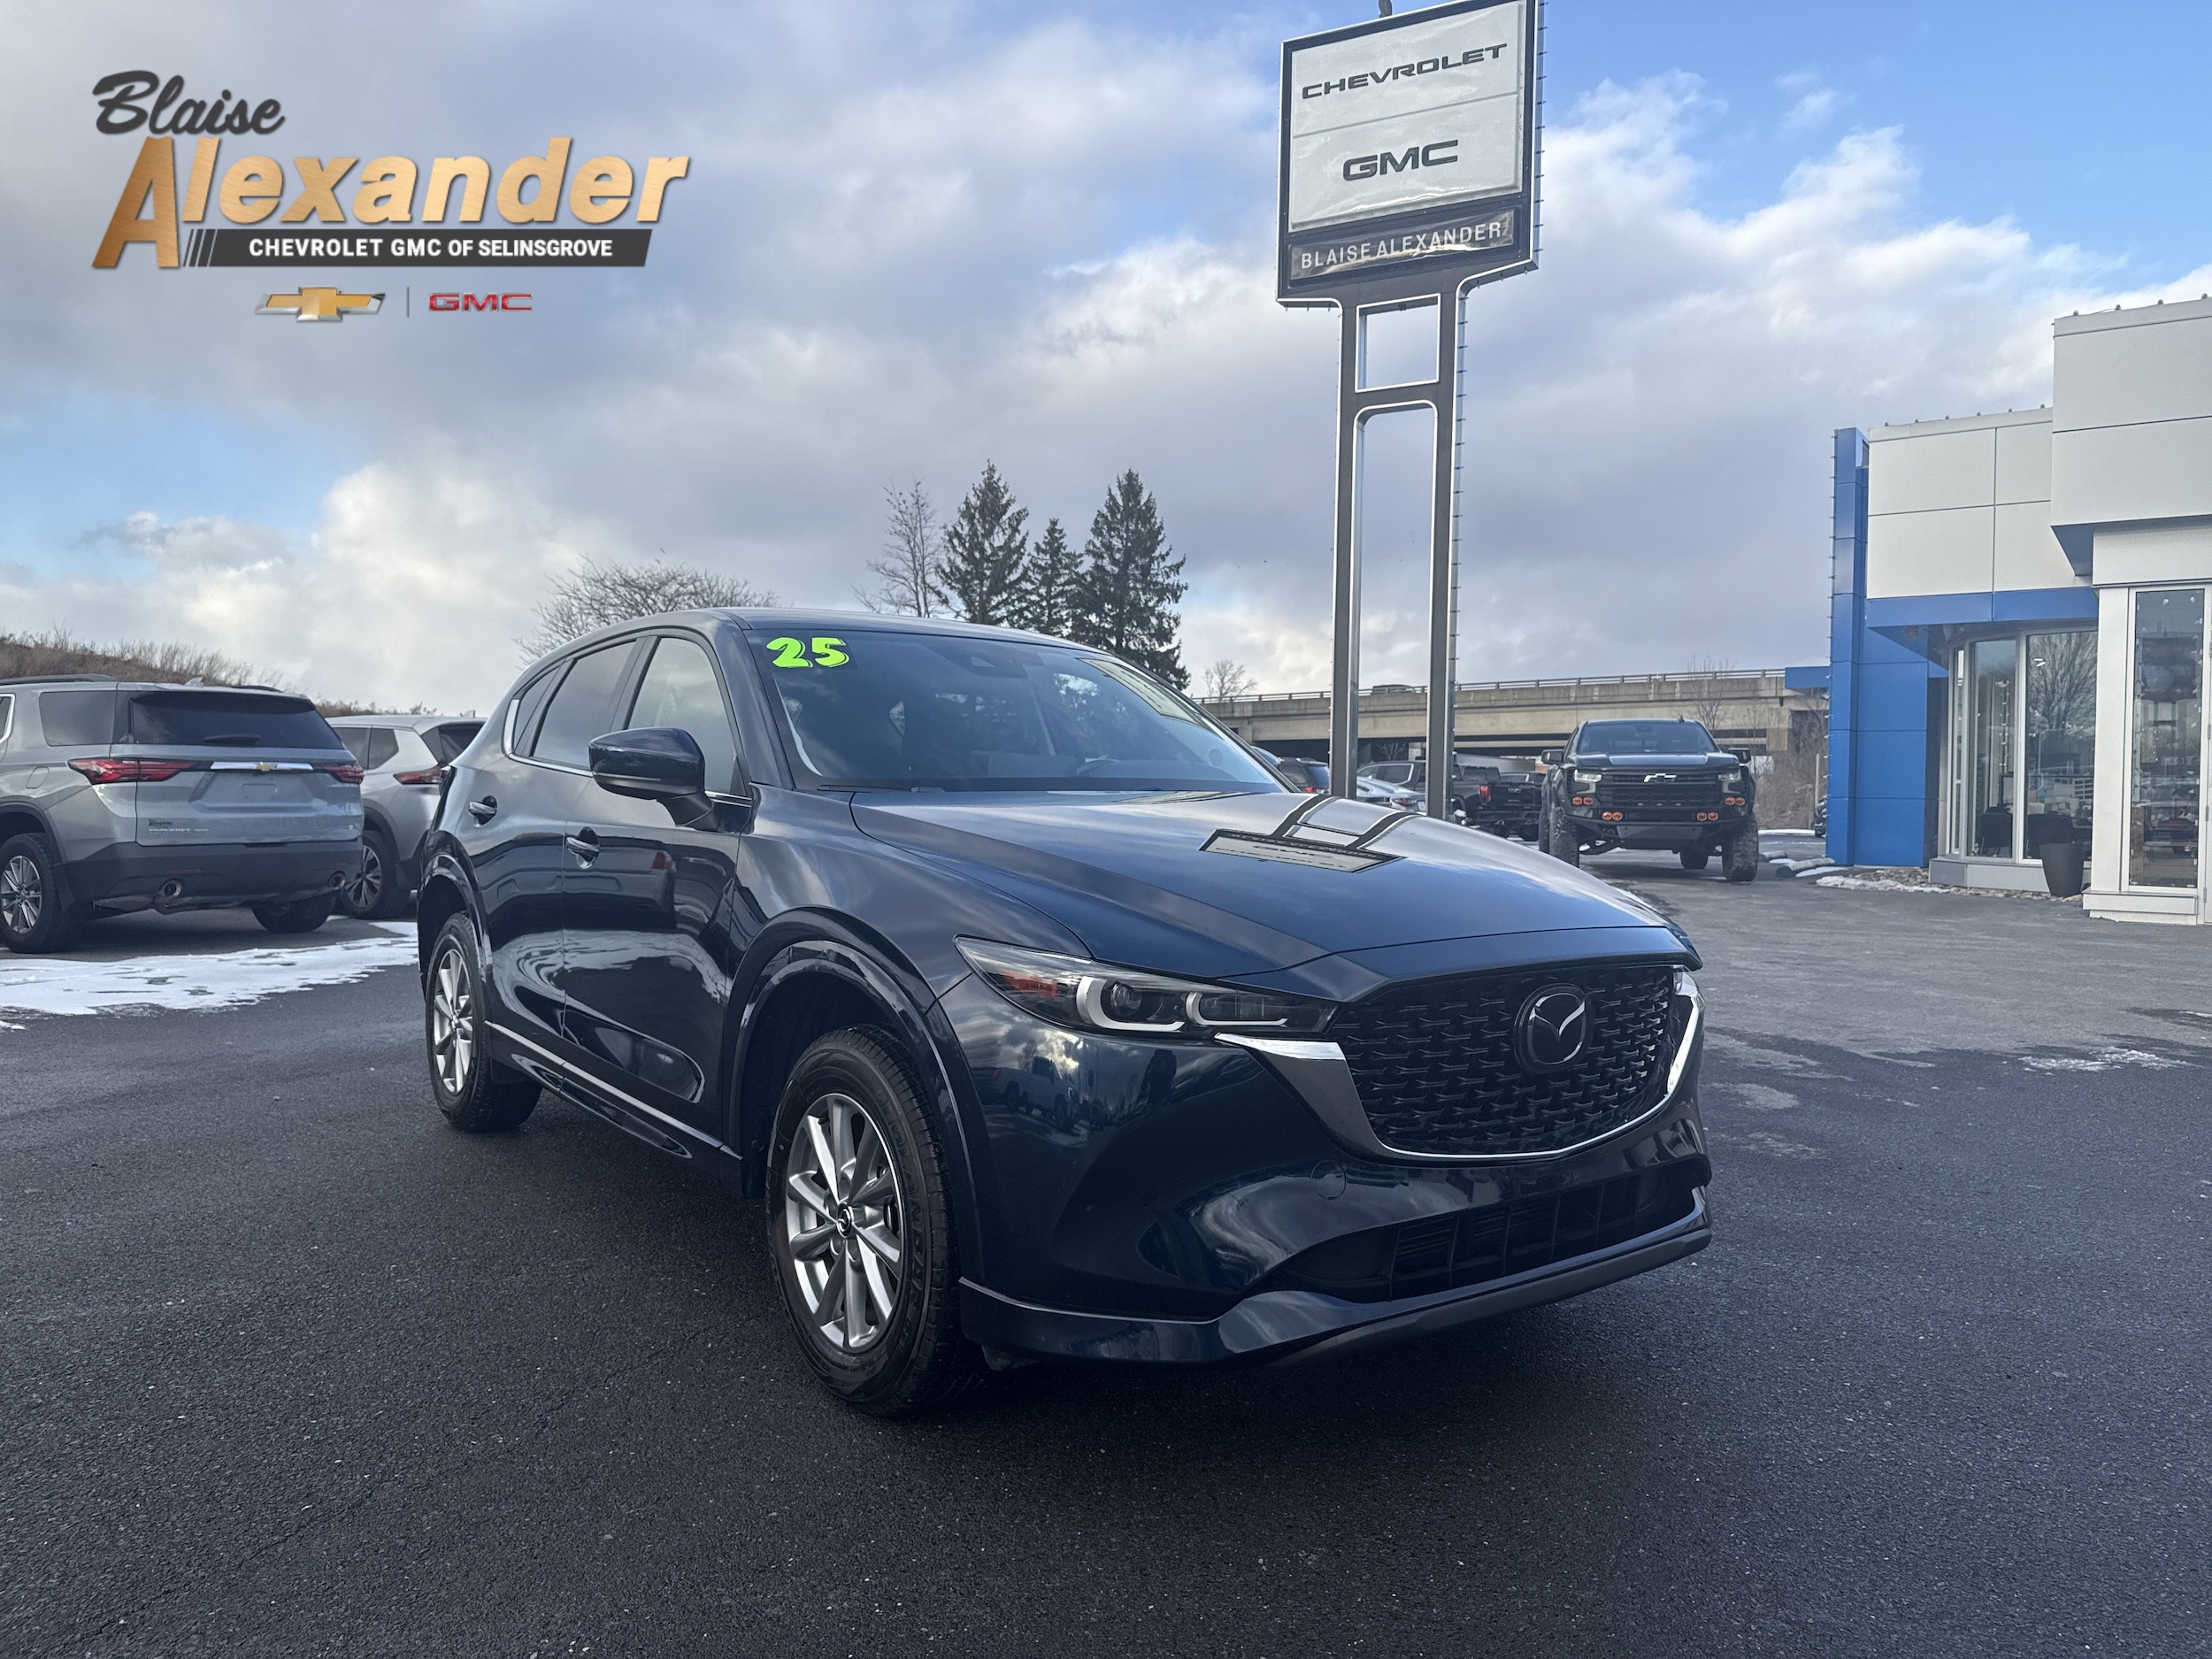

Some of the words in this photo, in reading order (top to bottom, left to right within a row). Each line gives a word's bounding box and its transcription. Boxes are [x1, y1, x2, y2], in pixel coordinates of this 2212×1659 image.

[1302, 43, 1507, 99] CHEVROLET
[1342, 139, 1458, 181] GMC
[1301, 242, 1371, 269] BLAISE
[1376, 221, 1502, 257] ALEXANDER
[765, 637, 849, 668] 25
